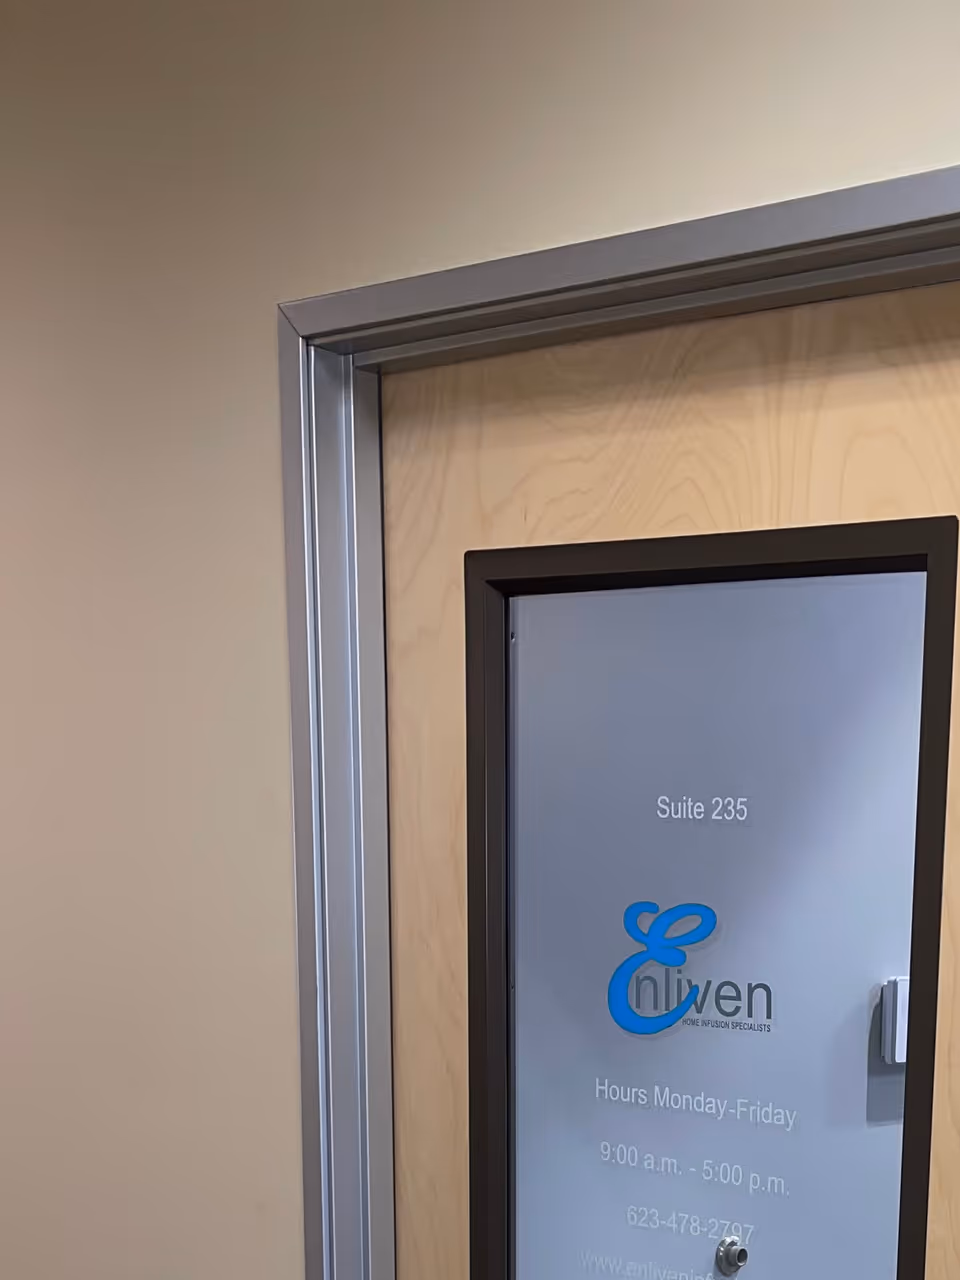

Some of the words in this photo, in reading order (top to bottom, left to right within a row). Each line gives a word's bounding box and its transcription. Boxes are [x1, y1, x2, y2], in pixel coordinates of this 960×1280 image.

[656, 795, 705, 819] Suite
[711, 797, 748, 820] 235
[607, 901, 773, 1035] Enliven
[682, 1018, 700, 1027] HOME
[701, 1019, 730, 1030] INFUSION
[731, 1021, 771, 1033] SPECIALISTS
[595, 1078, 648, 1104] Hours
[653, 1085, 797, 1132] Monday-Friday
[600, 1141, 638, 1167] 9:00
[643, 1153, 683, 1175] a.m.
[702, 1159, 743, 1186] 5:00
[749, 1172, 790, 1197] p.m.
[626, 1205, 755, 1245] 623-478-2797
